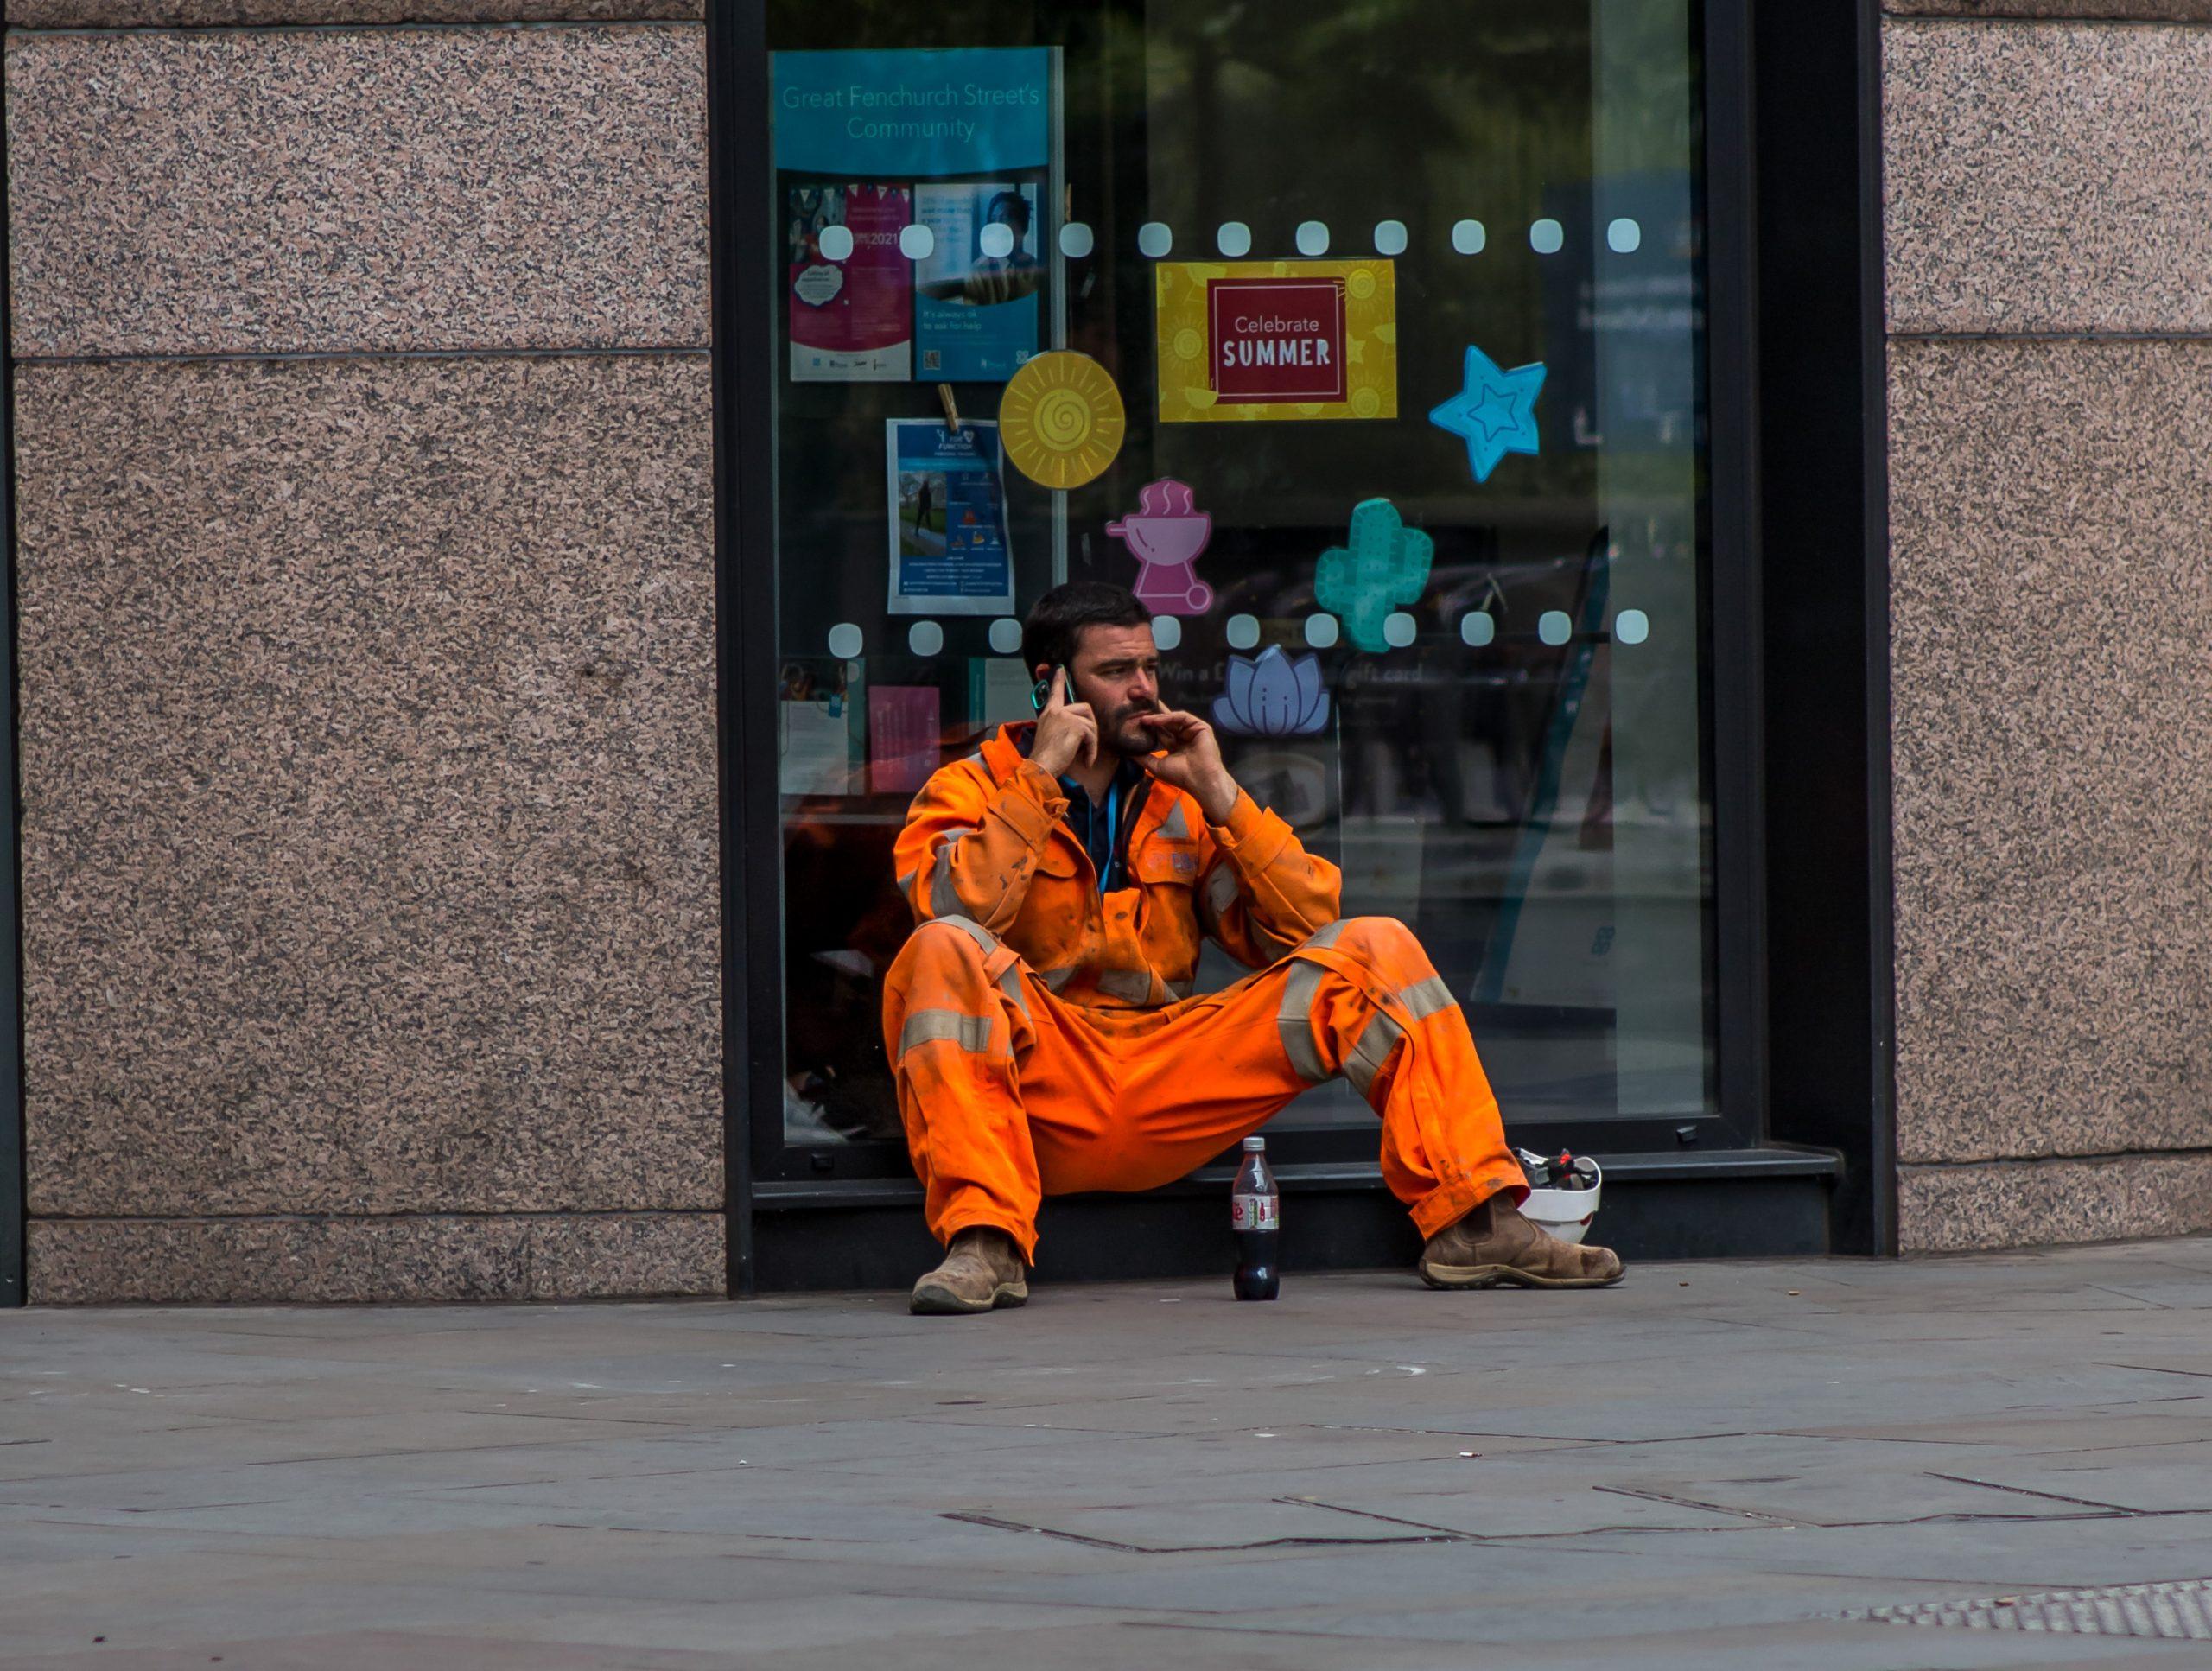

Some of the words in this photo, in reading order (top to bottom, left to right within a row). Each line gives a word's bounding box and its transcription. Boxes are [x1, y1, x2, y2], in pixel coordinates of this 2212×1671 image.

[782, 86, 844, 109] Great
[849, 84, 959, 109] Fenchurch
[964, 83, 1039, 105] Street's
[847, 117, 976, 143] Community
[870, 232, 898, 245] 2021
[1235, 315, 1319, 334] Celebrate
[1223, 338, 1331, 367] SUMMER
